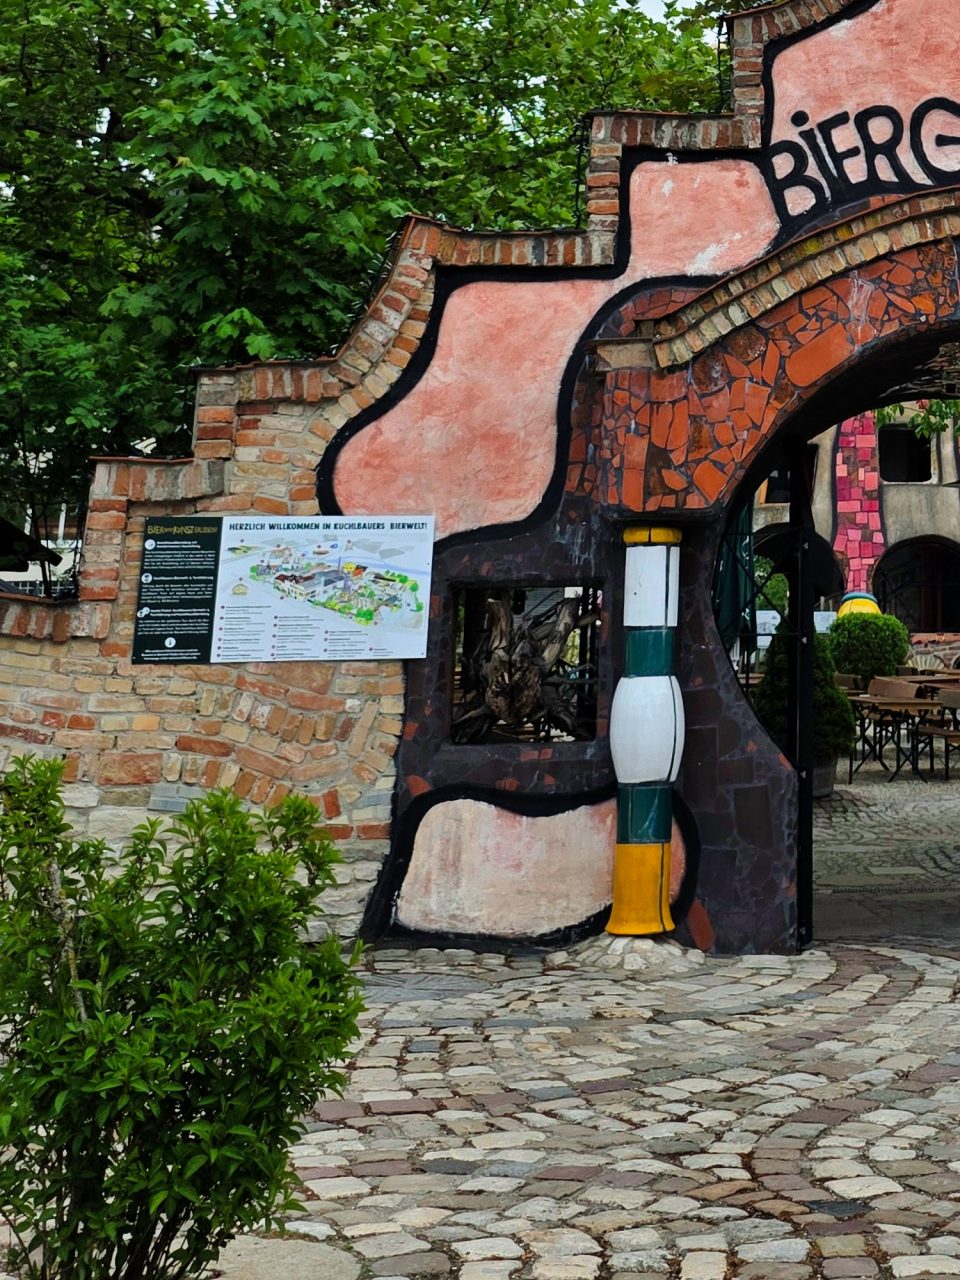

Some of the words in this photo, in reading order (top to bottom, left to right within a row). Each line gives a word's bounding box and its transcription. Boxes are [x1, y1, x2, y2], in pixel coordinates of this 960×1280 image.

[229, 523, 266, 531] HERZLICH
[269, 522, 320, 530] WILLKOMMEN
[323, 522, 331, 530] IN
[334, 522, 385, 530] KUCHLBAUERS
